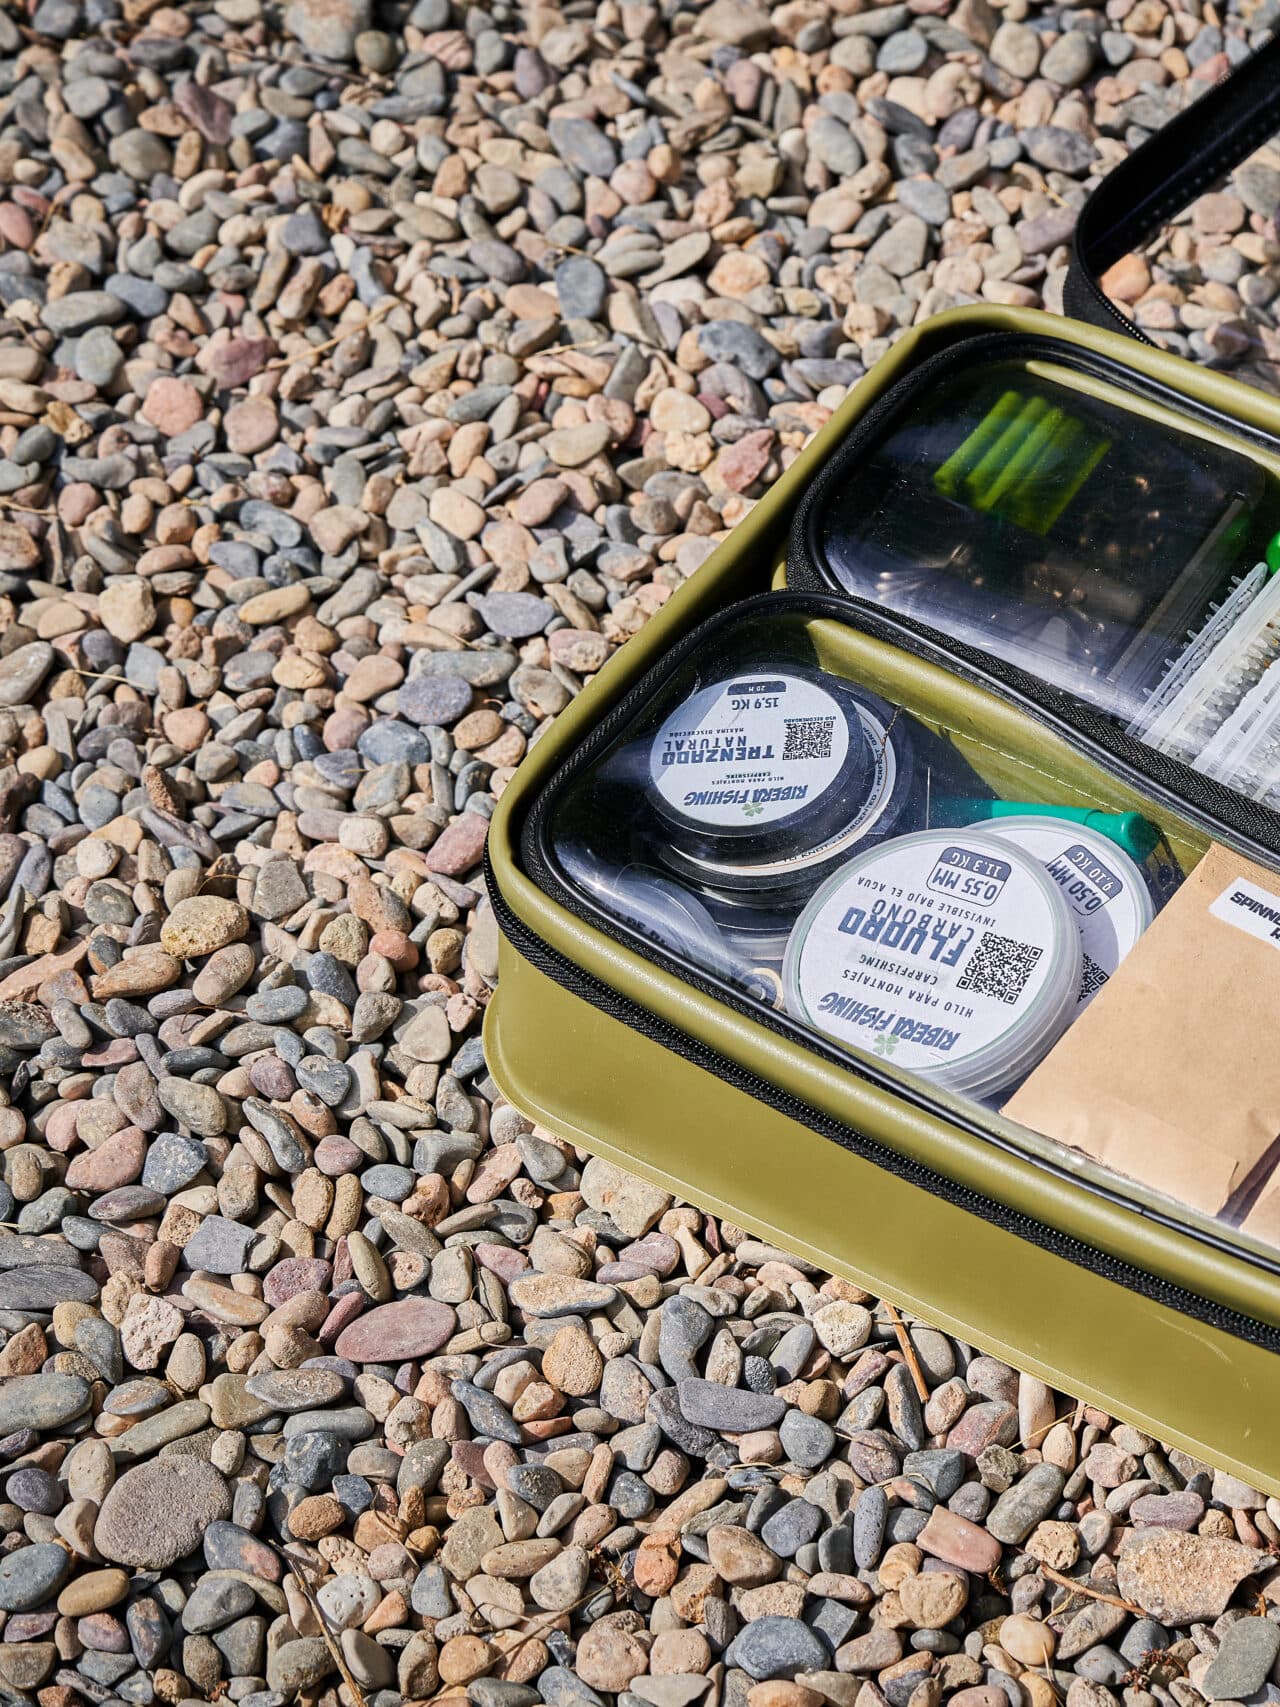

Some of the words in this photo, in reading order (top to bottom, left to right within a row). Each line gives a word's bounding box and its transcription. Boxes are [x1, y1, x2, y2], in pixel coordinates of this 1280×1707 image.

[732, 699, 750, 710] KG
[754, 698, 780, 708] 15,9
[664, 736, 746, 751] NATURAL
[662, 745, 774, 765] TRENZADO
[684, 790, 750, 806] FISHING
[752, 785, 808, 803] RIBERA
[951, 852, 970, 868] KG
[1072, 852, 1092, 870] KG
[932, 868, 961, 890] MM
[1048, 860, 1075, 886] MM
[1088, 868, 1114, 892] 9,10
[858, 877, 886, 892] AGUA
[891, 887, 902, 898] EL
[961, 878, 998, 900] 0,55
[907, 892, 934, 908] BAJO
[1068, 881, 1102, 910] 0,50
[872, 900, 974, 944] CARBONO
[938, 903, 996, 927] INVISIBLE
[838, 907, 966, 967] FLUORO
[859, 954, 938, 985] CARPFISHING
[842, 969, 903, 996] MONTAJES
[908, 989, 940, 1006] PARA
[817, 992, 896, 1032] FISHING
[944, 1001, 974, 1018] HILO
[891, 1016, 961, 1050] RIBERA
